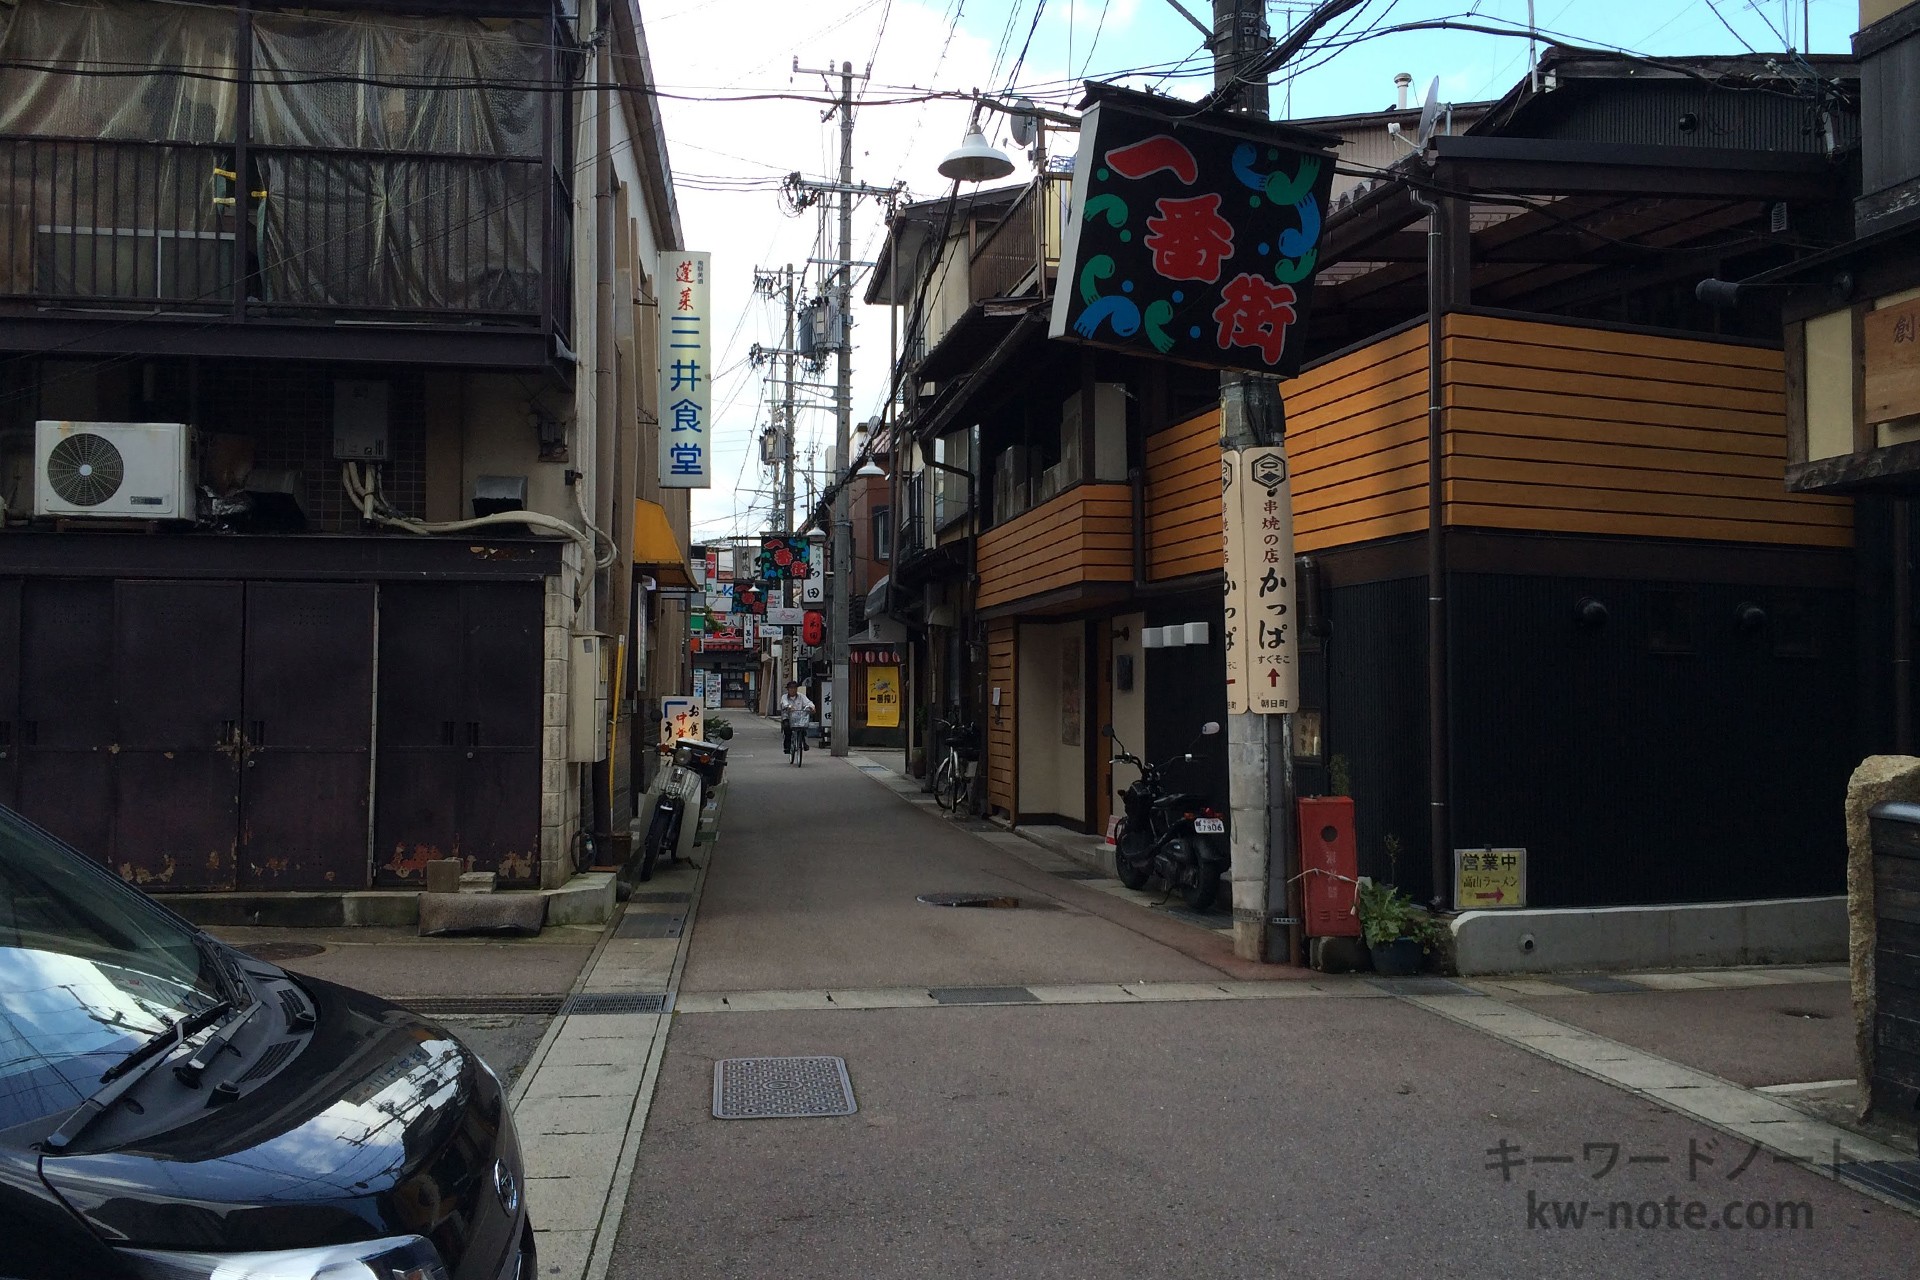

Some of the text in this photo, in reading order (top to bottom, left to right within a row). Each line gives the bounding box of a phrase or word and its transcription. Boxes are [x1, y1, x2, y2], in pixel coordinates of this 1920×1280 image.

[1104, 134, 1297, 365] 一番街
[675, 260, 696, 311] 蓬莱
[670, 316, 703, 475] 三井食堂
[1262, 499, 1280, 564] 串焼の店
[764, 538, 809, 578] 一番街
[1258, 567, 1287, 650] かっぱ
[1257, 654, 1290, 665] すぐそこ
[869, 694, 897, 704] 一番搾り
[1261, 699, 1288, 709] 朝日町
[1463, 853, 1517, 871] 営業中
[1463, 876, 1518, 888] 高山ラーメン
